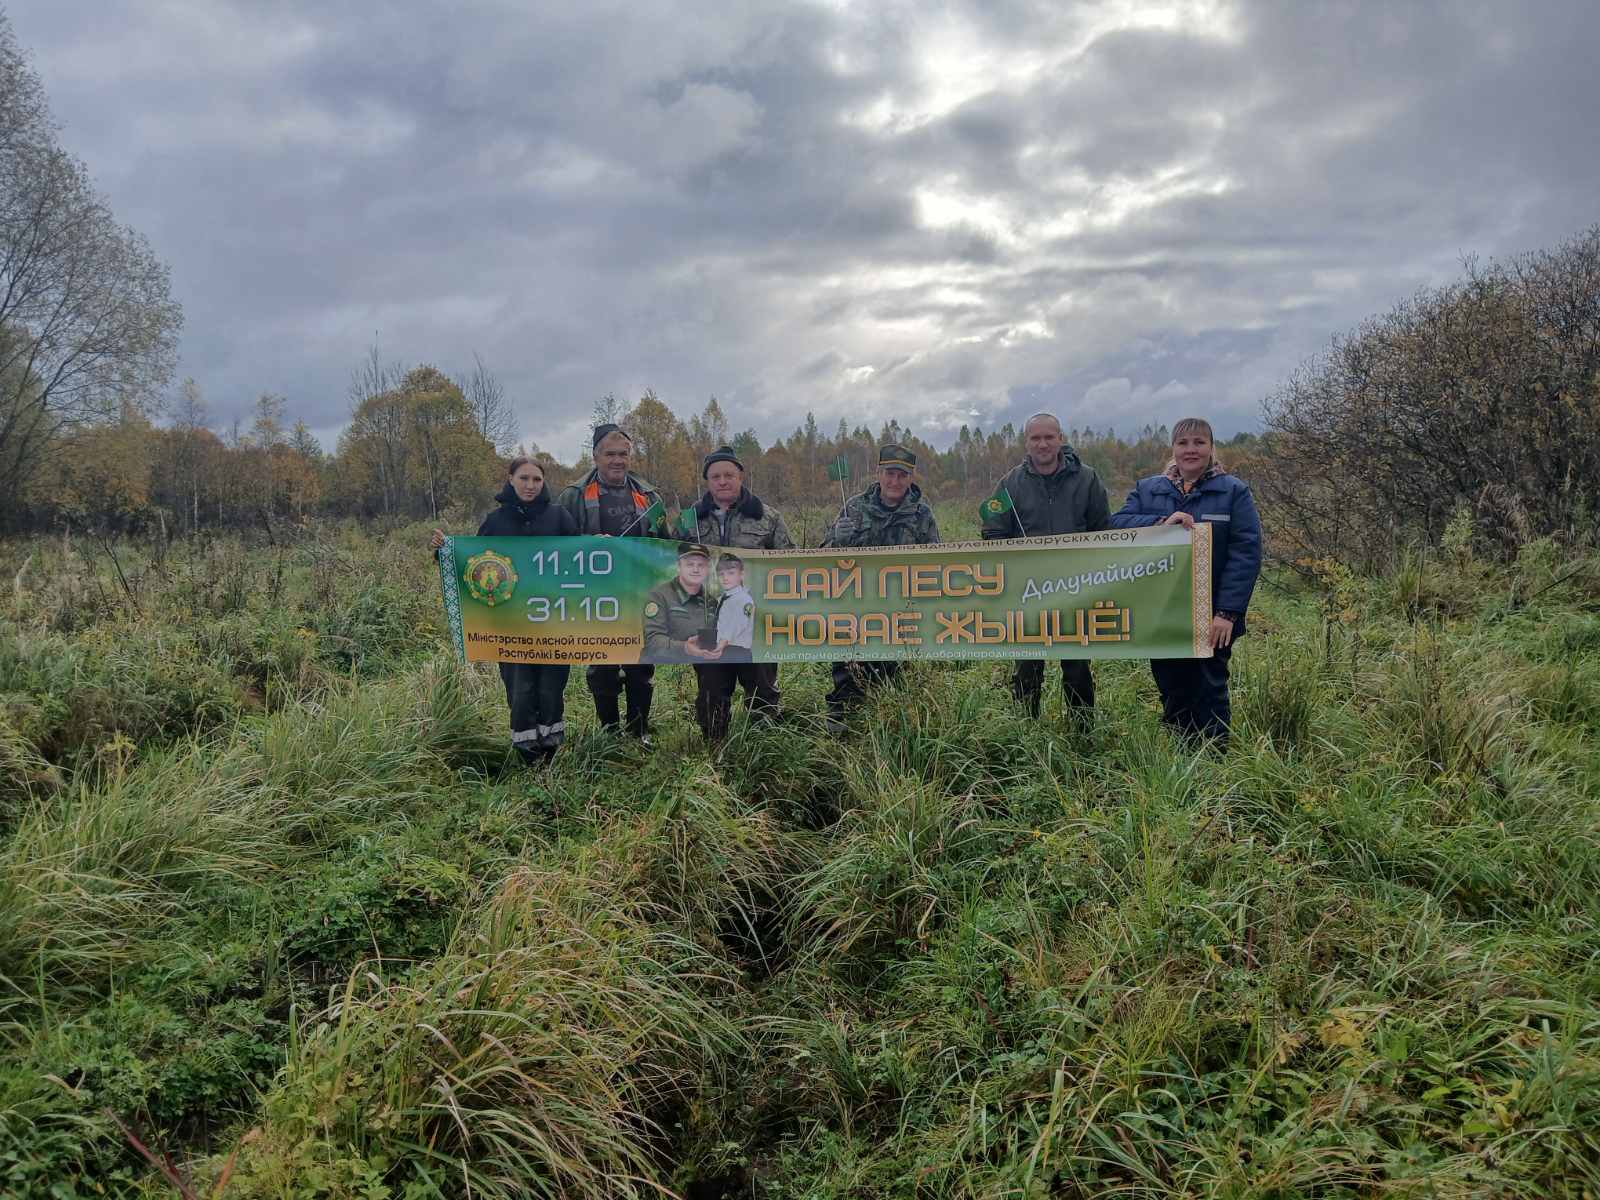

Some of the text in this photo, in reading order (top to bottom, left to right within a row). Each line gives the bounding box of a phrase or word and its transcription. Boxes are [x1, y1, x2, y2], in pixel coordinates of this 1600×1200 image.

[1094, 530, 1138, 543] лясоў
[532, 550, 613, 576] 11.10
[763, 559, 862, 600] ДАЙ
[1021, 553, 1177, 604] Далучайцеся!
[527, 596, 620, 622] 31.10
[765, 600, 1132, 647] НОВАЕ ЖЫЦЦЁ!
[467, 632, 641, 649] Міністэрства лясной гаспадаркі
[499, 647, 609, 663] Рэспублікі Беларусь
